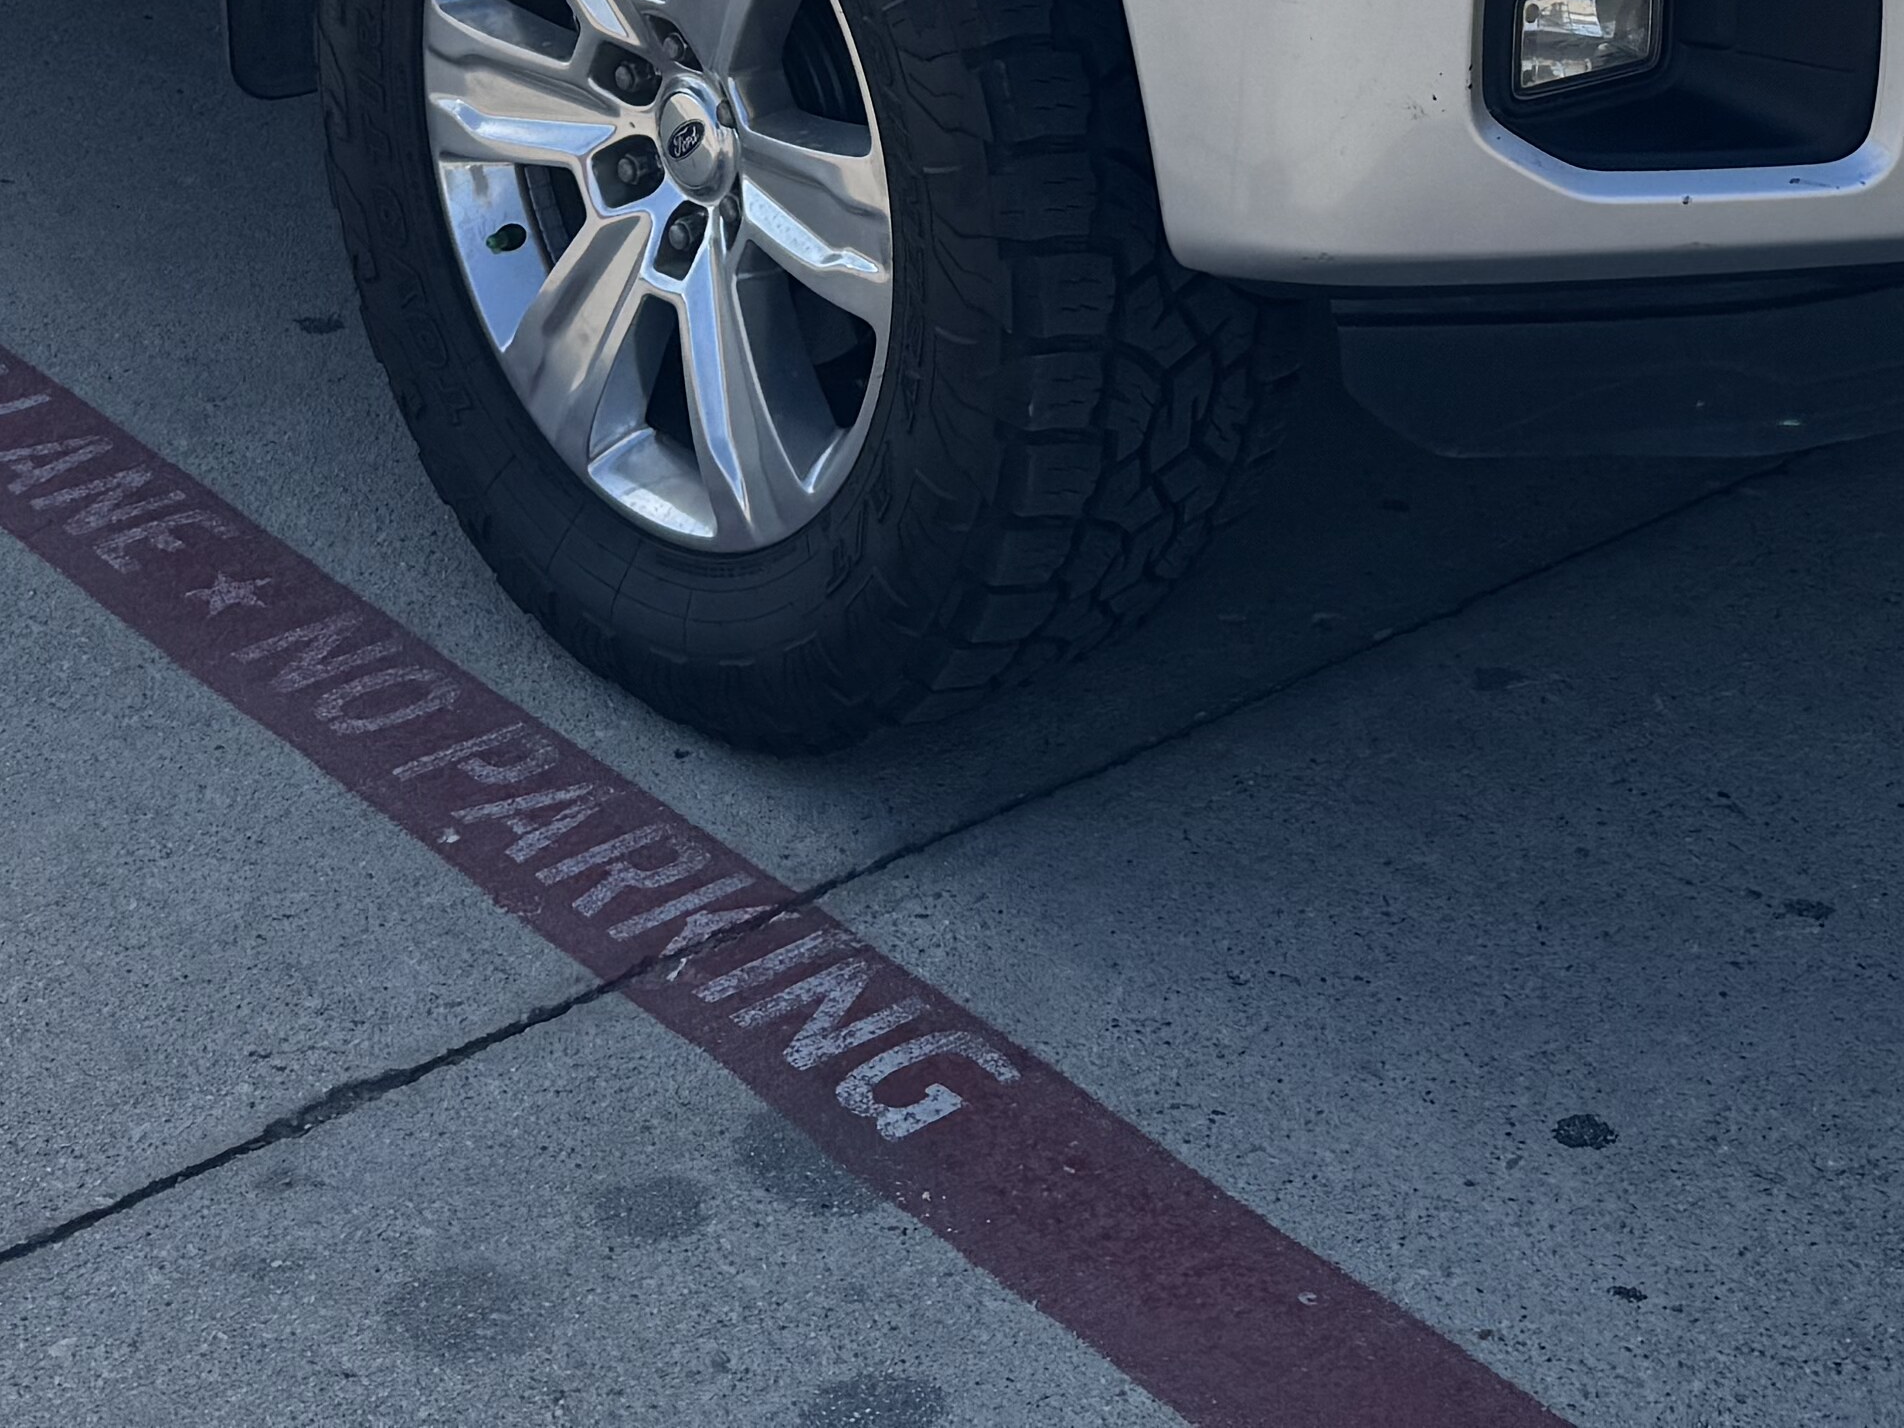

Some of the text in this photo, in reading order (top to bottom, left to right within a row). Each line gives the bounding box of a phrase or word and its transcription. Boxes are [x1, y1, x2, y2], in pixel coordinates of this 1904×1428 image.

[673, 125, 698, 157] Ford
[230, 613, 464, 735] NO
[390, 721, 1022, 1141] PARKING
